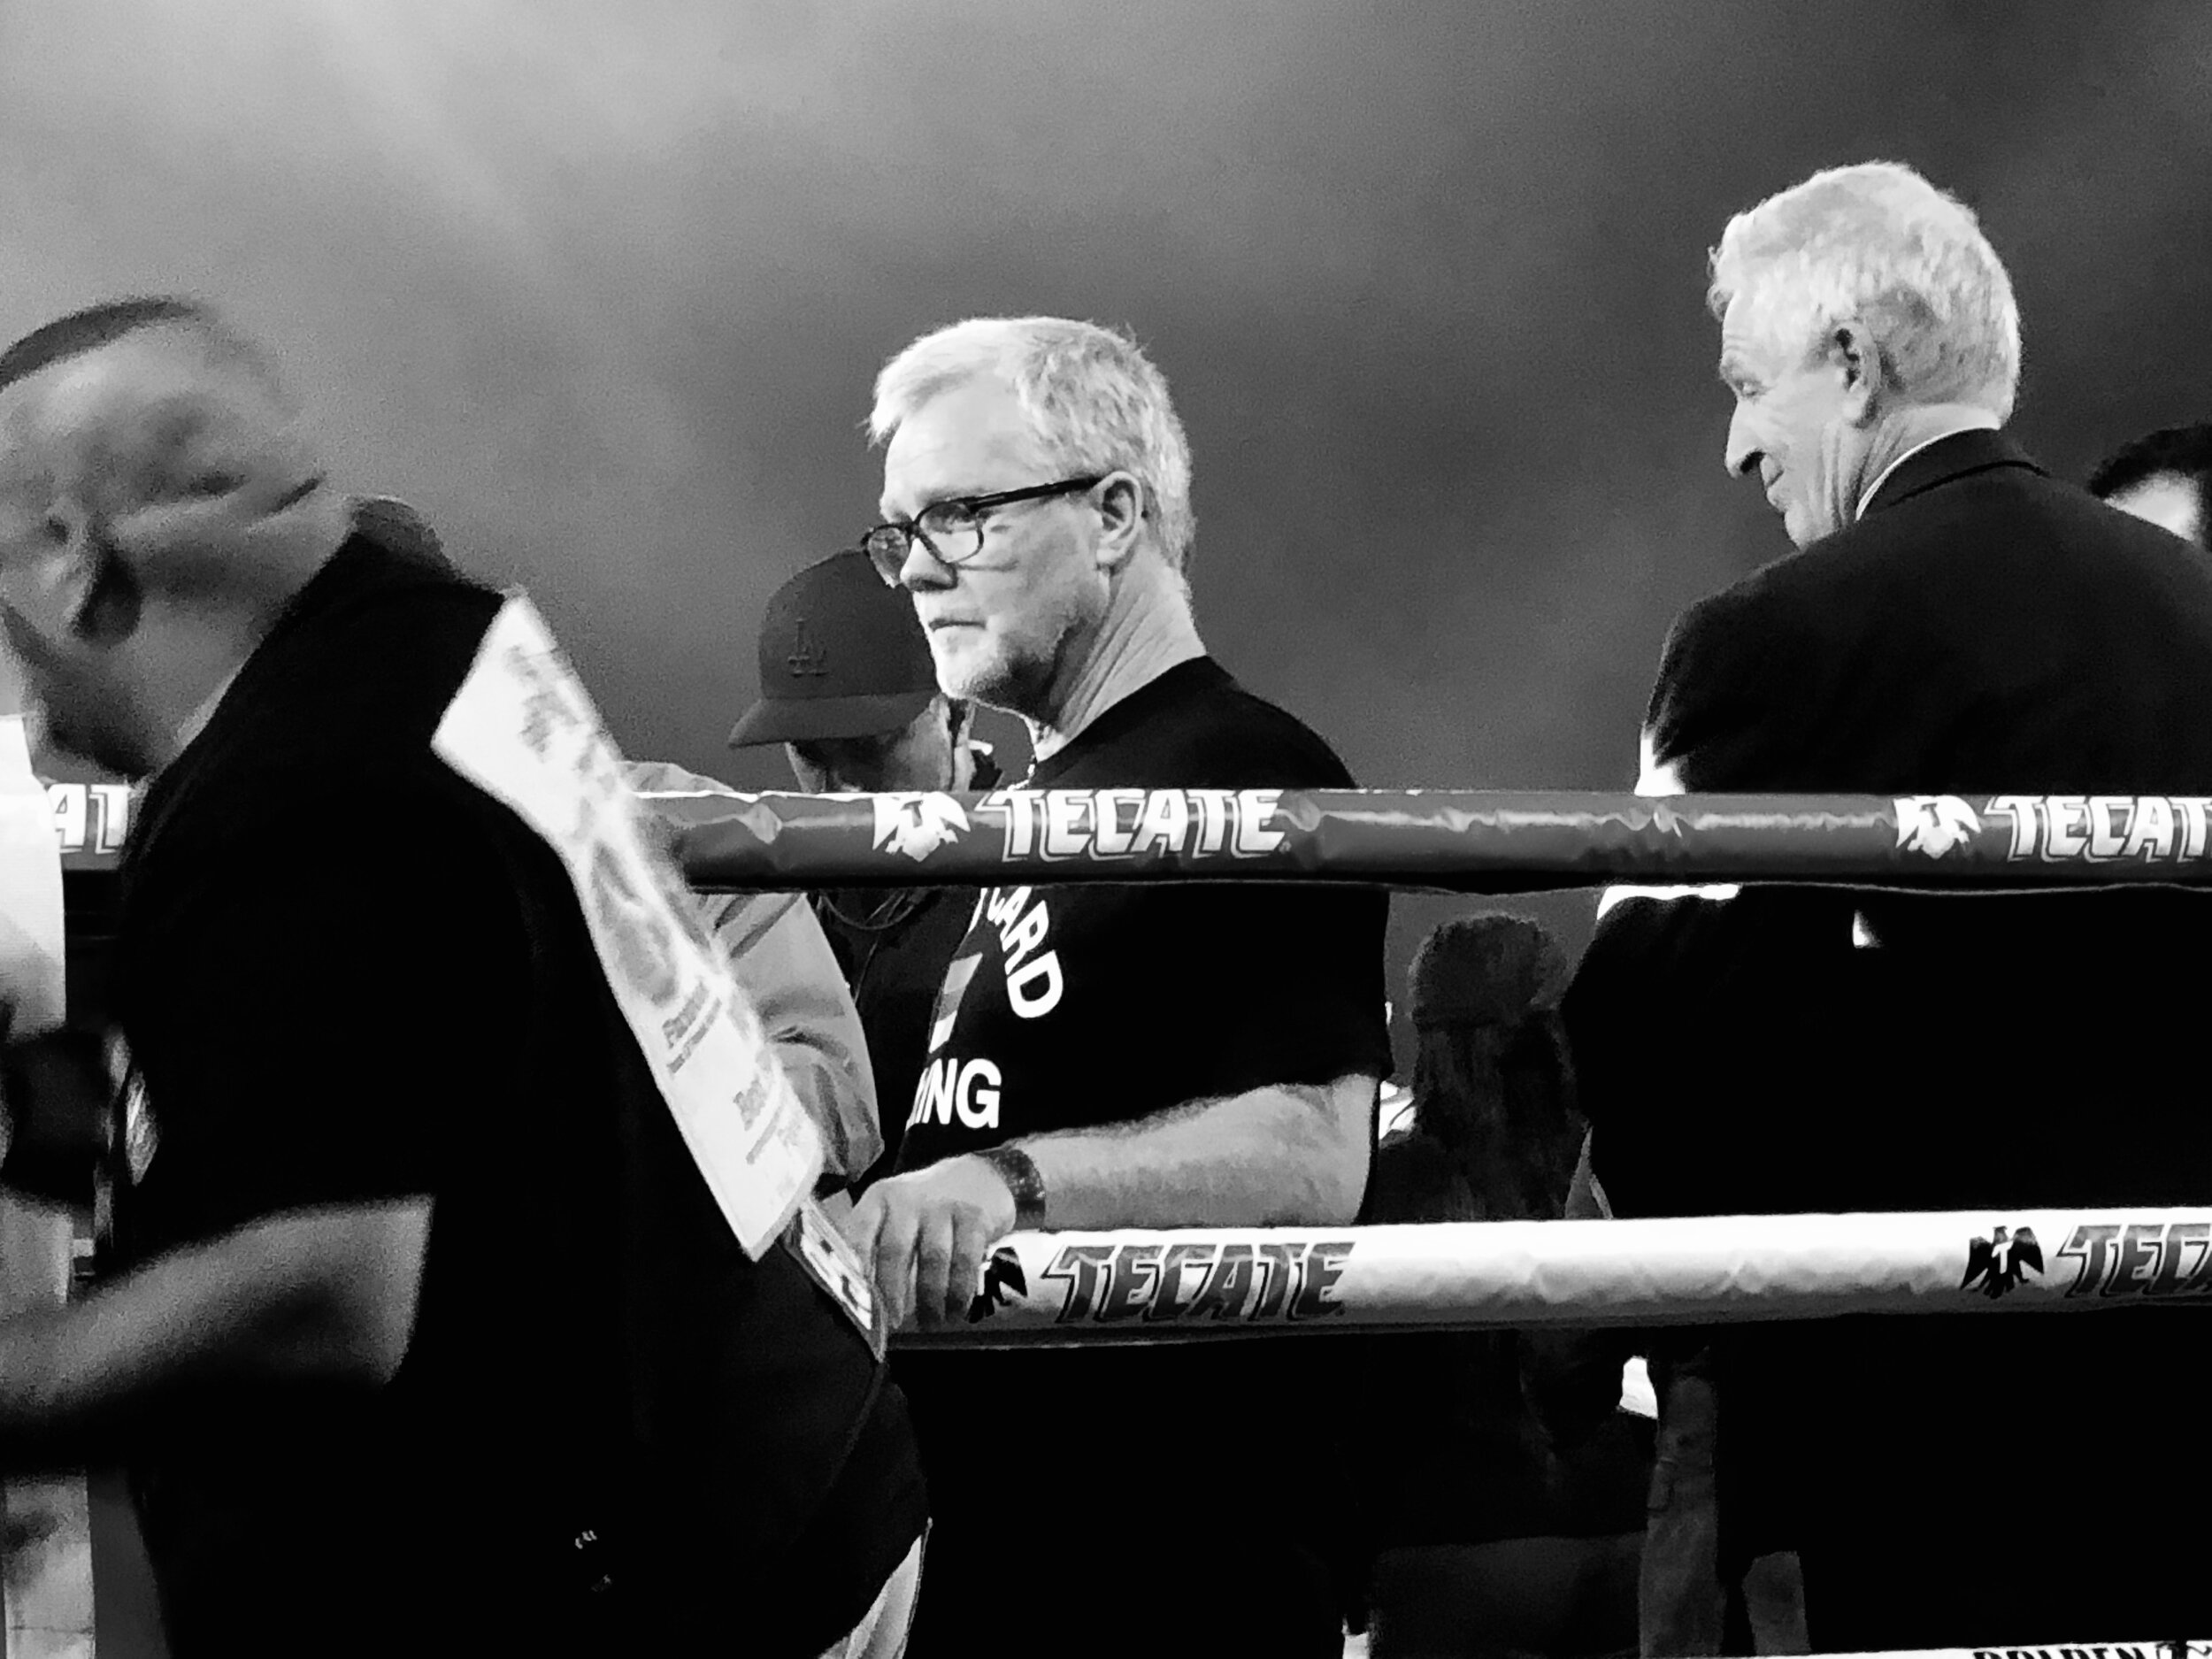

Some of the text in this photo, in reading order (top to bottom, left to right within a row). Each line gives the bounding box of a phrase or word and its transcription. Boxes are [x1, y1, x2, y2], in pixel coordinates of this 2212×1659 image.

[47, 783, 133, 855] AT
[974, 788, 1286, 863] TECATE
[1984, 795, 2212, 864] TECAT
[1041, 1241, 1356, 1323] TECATE
[2056, 1223, 2212, 1298] TEC
